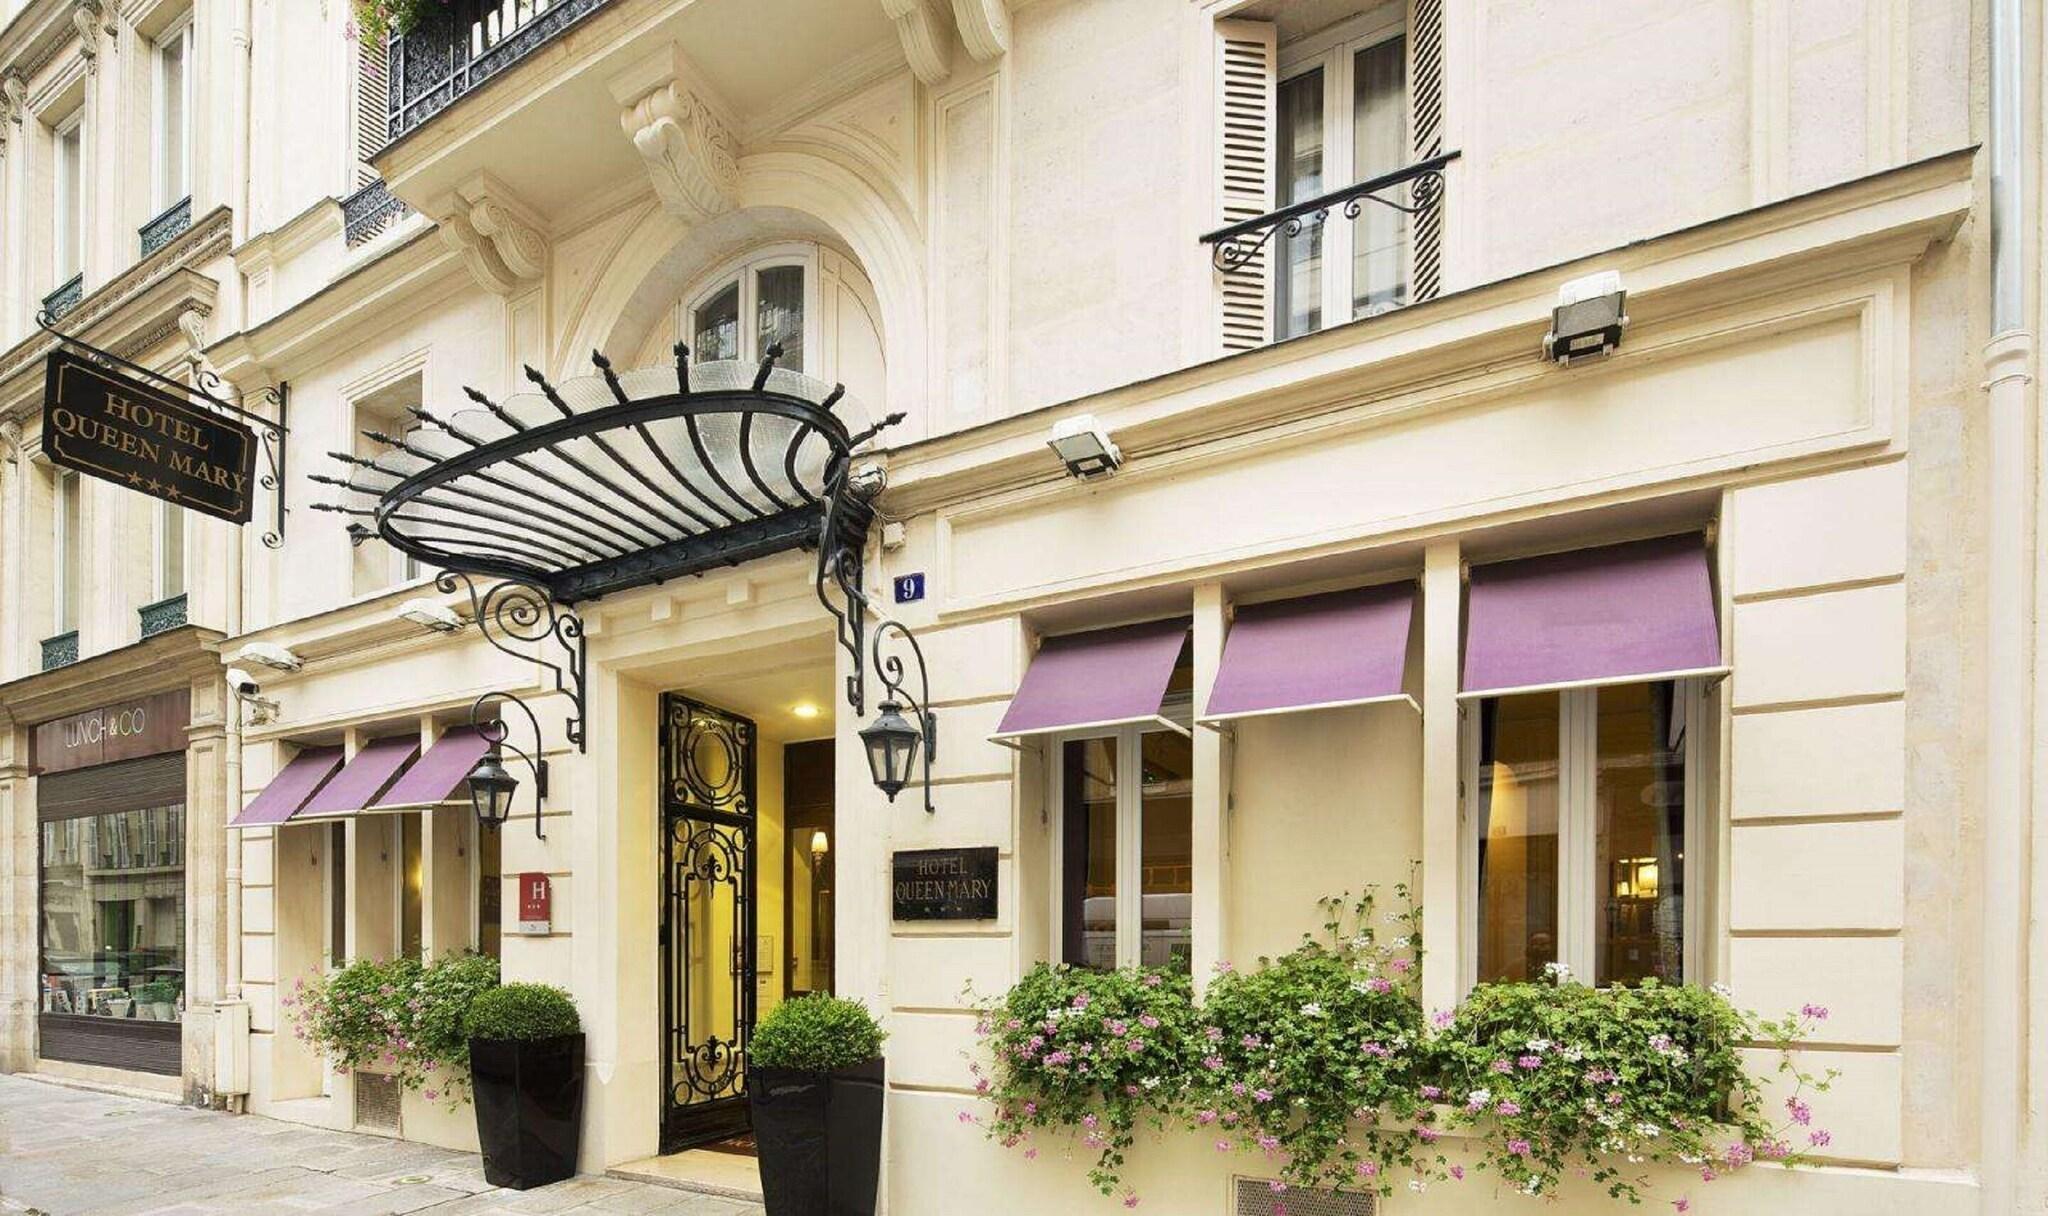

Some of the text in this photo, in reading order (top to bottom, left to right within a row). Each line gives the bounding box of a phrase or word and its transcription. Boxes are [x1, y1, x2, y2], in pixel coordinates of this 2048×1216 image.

[104, 392, 209, 450] HOTEL
[52, 408, 247, 494] QUEEN MARY
[903, 578, 915, 599] 9
[919, 857, 968, 876] HOTEL
[533, 881, 545, 900] H
[895, 879, 991, 904] QUEEN MARY
